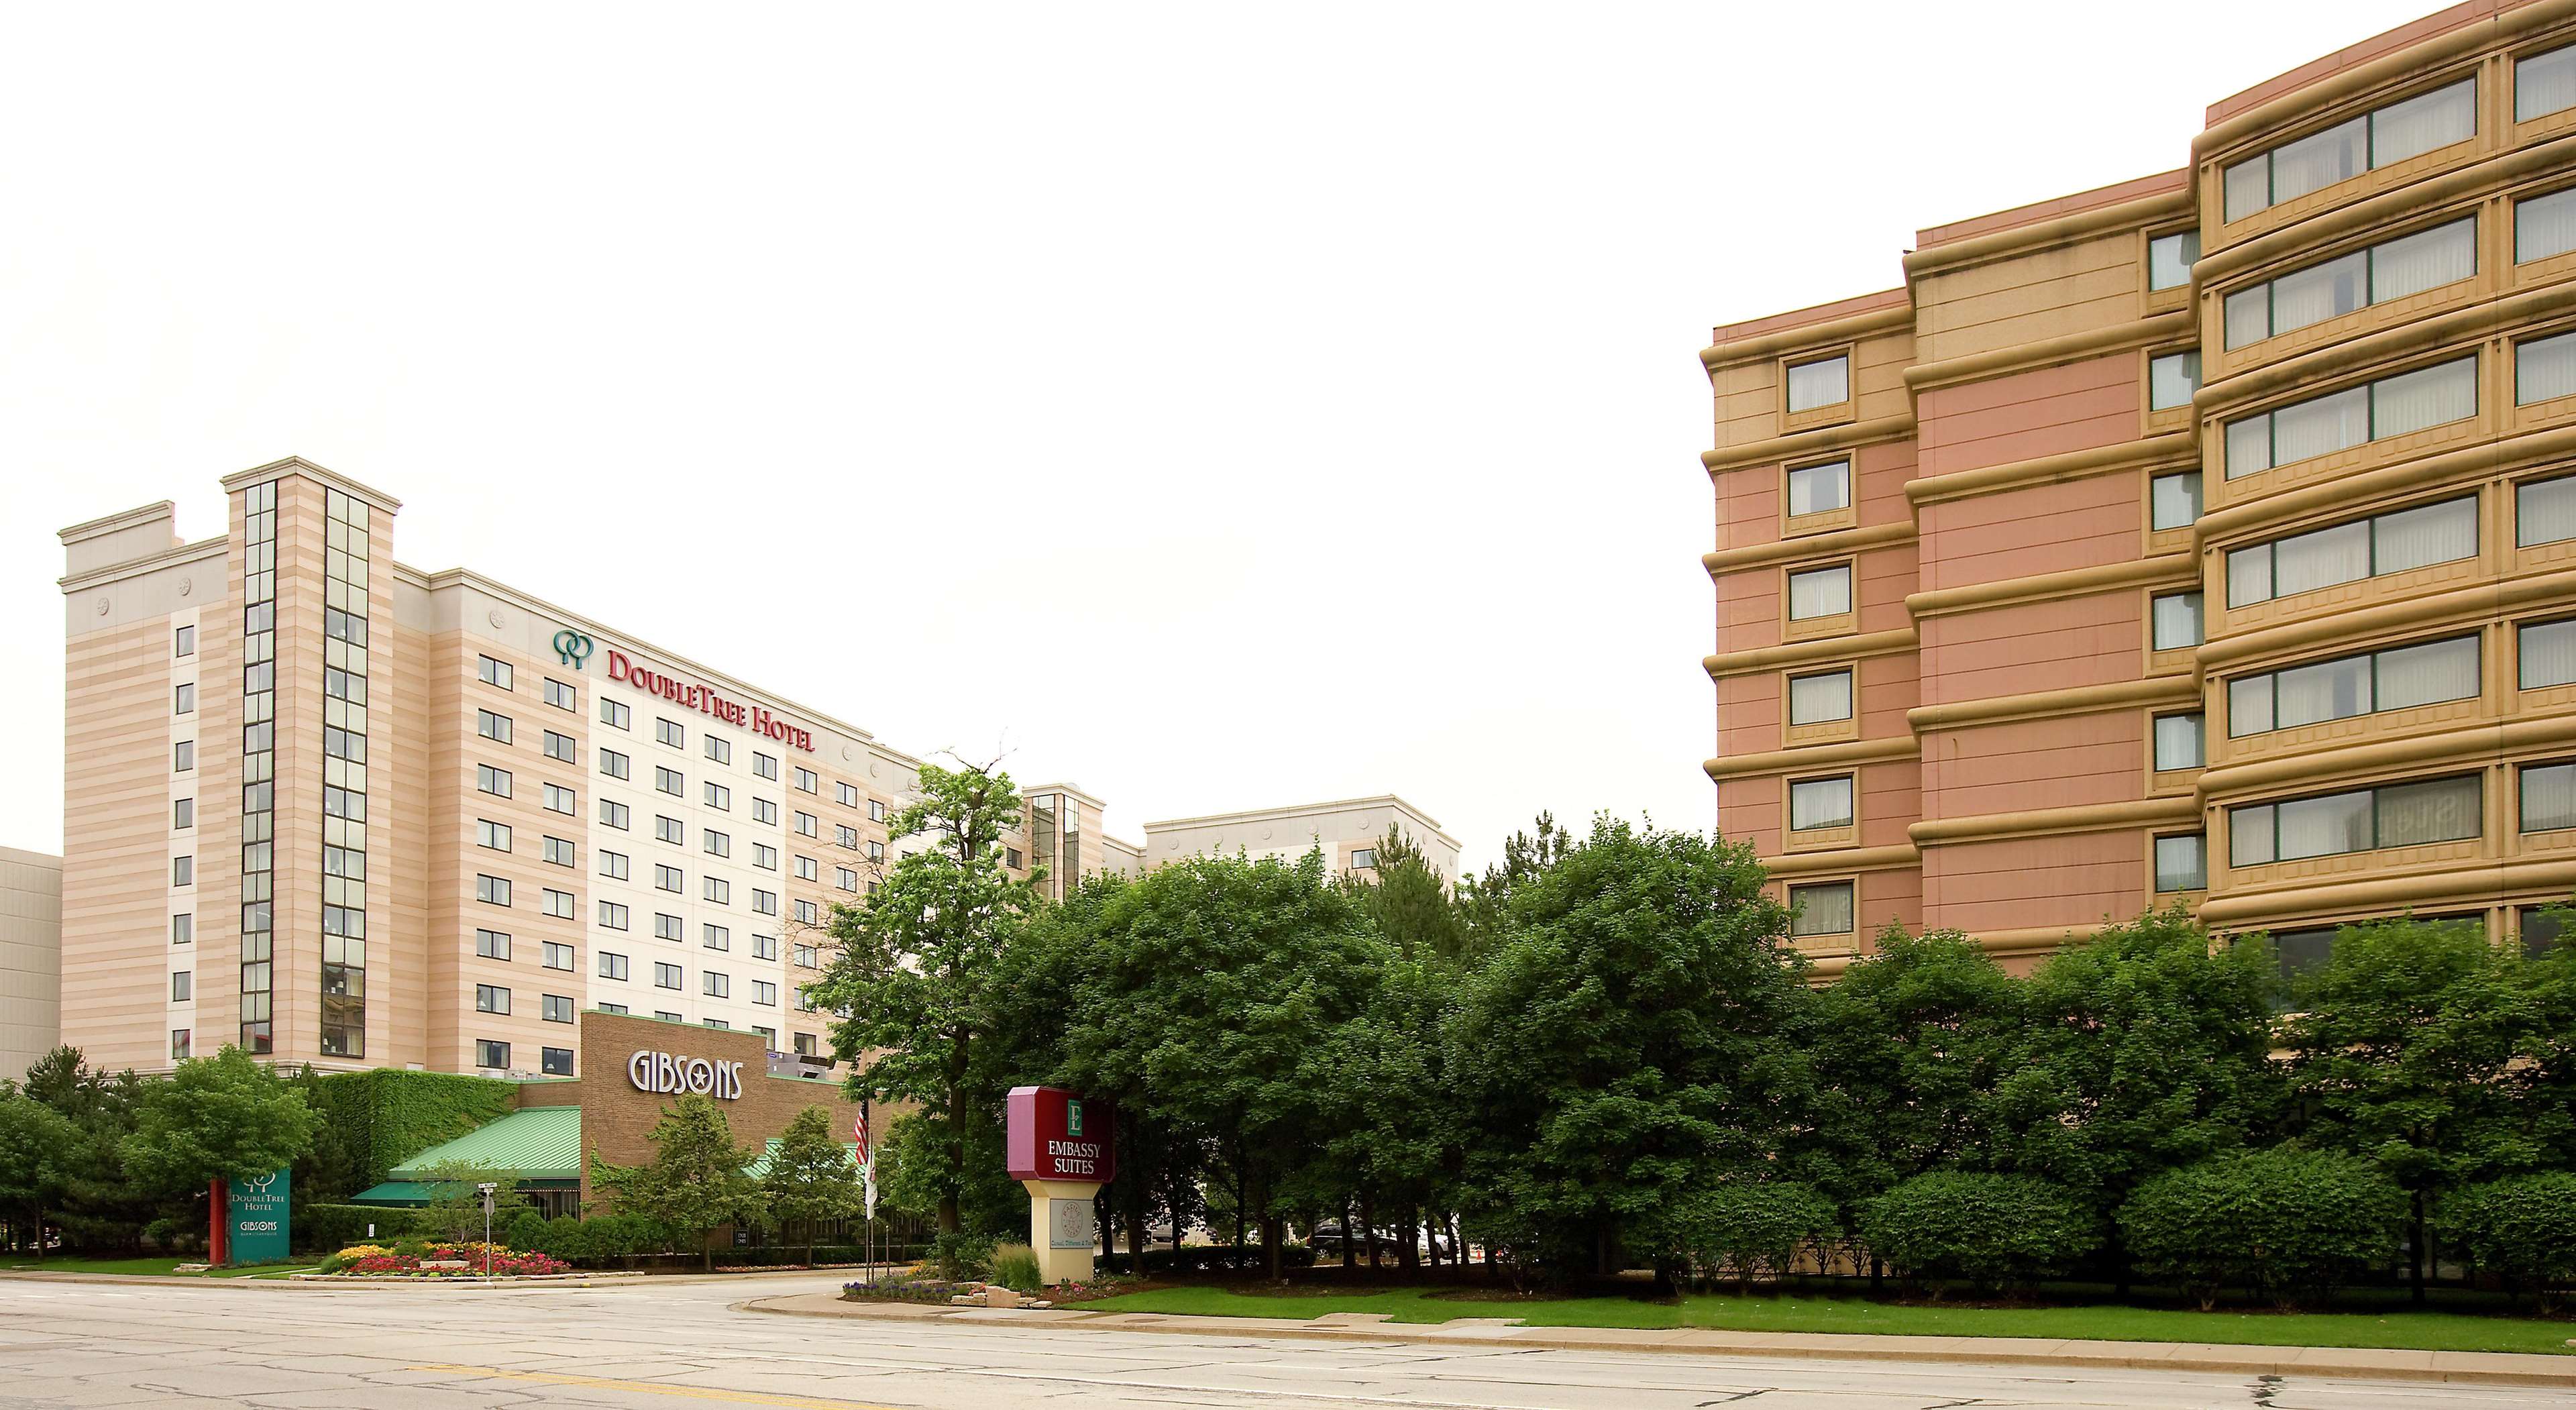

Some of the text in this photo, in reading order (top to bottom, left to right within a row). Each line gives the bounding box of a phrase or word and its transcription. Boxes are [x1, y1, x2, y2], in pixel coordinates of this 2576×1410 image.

[608, 649, 816, 753] DOUBLETREE HOTEL
[627, 1050, 743, 1100] GIBSONS
[1048, 1140, 1101, 1158] EMBASSY
[1055, 1158, 1094, 1175] SUITES
[245, 1203, 273, 1211] HOTEL
[240, 1221, 278, 1231] GIBSONS
